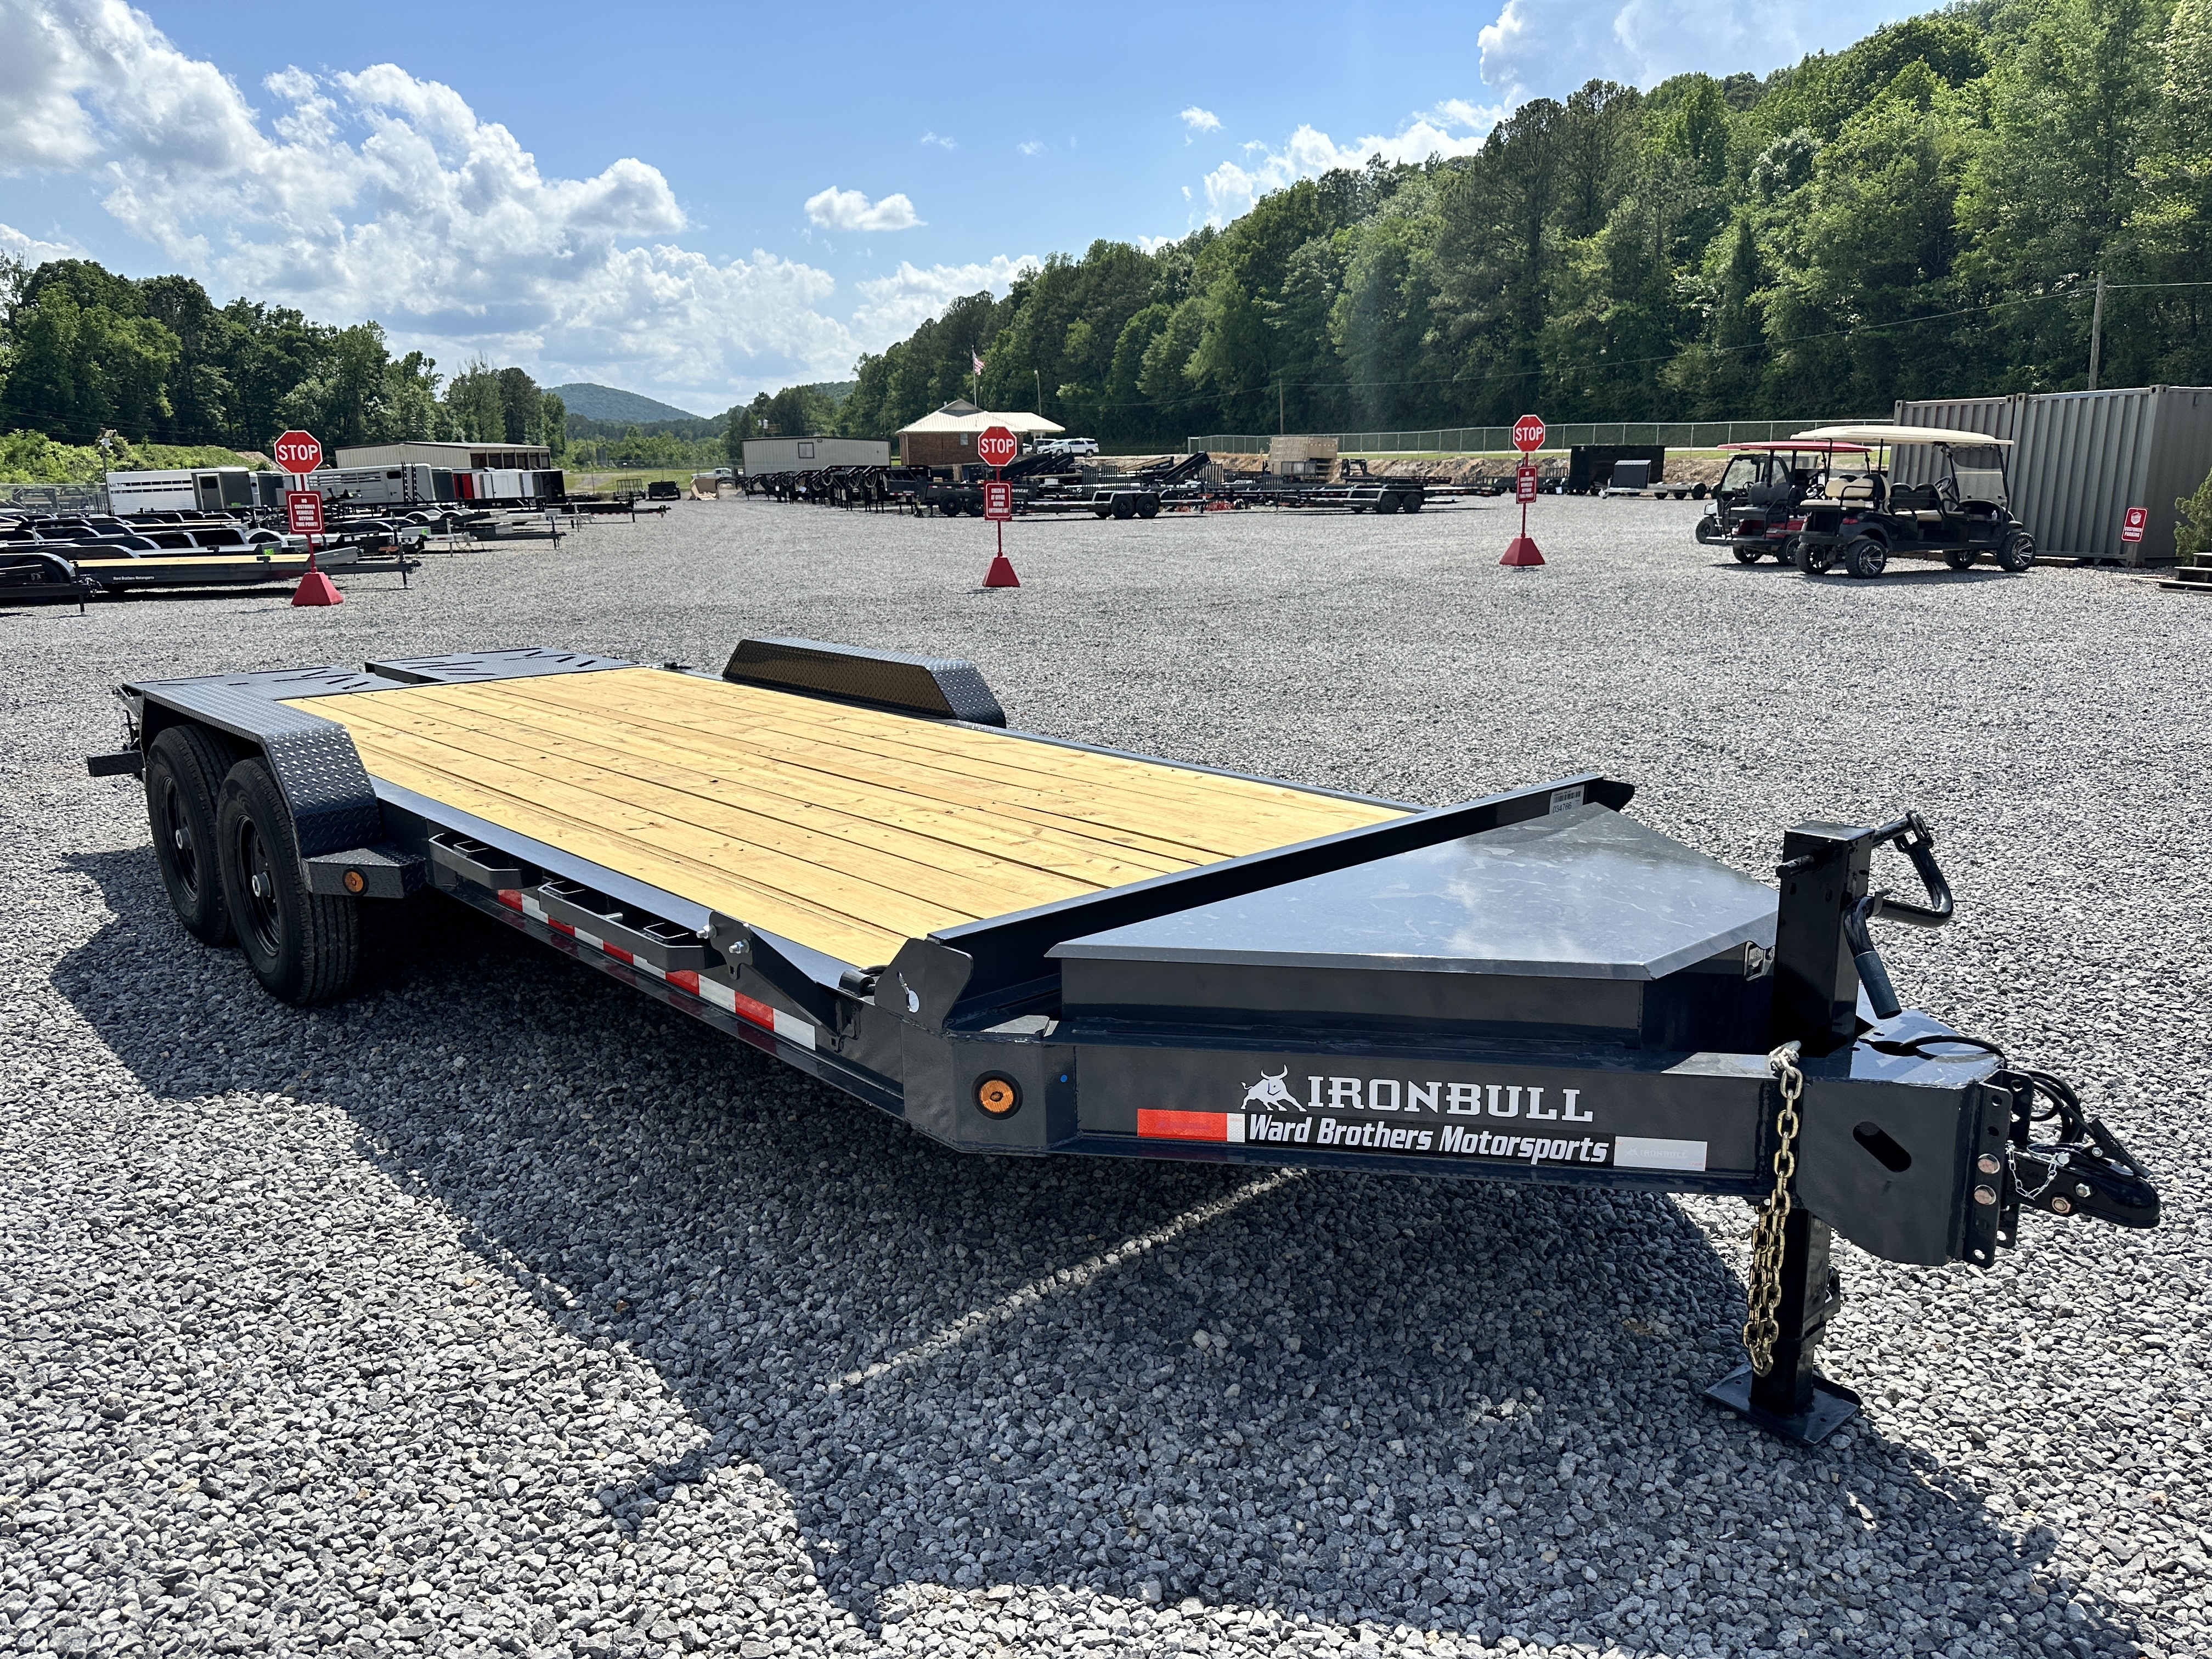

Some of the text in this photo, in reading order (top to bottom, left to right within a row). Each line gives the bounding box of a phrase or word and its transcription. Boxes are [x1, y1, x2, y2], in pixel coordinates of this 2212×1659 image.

[1515, 426, 1543, 442] STOP
[278, 444, 318, 461] STOP
[980, 438, 1014, 454] STOP
[1307, 1076, 1593, 1122] IRONBULL
[1249, 1114, 1610, 1165] Ward Brothers Motorsports
[1639, 1149, 1689, 1159] IRONBULL
